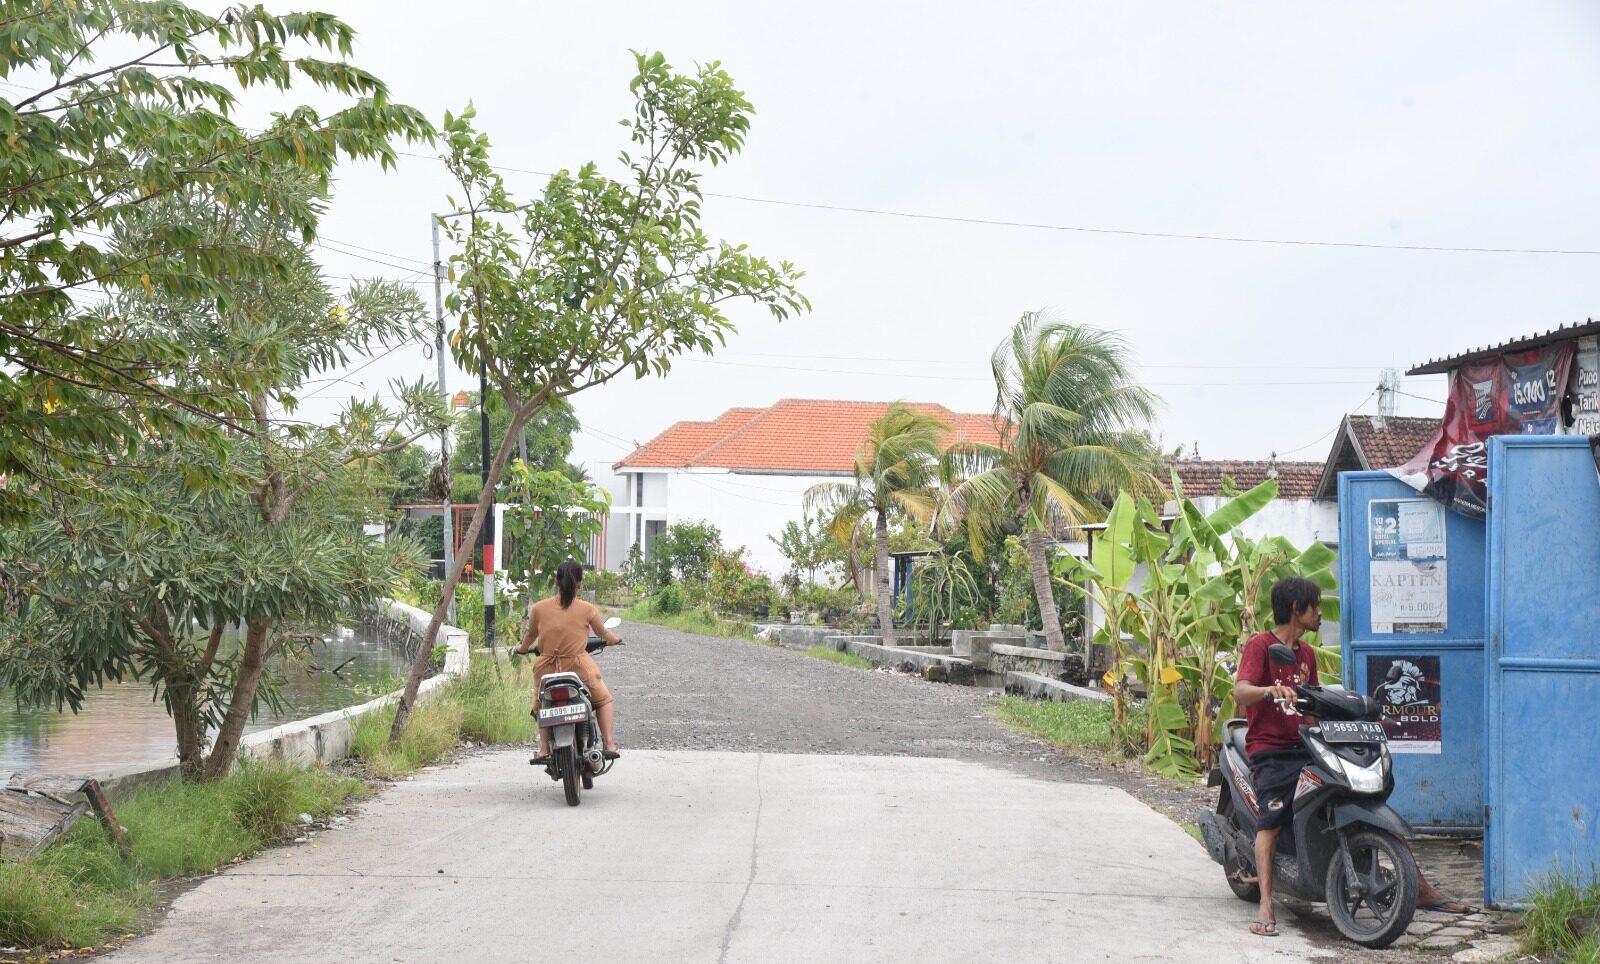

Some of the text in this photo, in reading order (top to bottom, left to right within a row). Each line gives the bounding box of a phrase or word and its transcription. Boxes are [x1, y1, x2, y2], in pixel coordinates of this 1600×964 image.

[1546, 369, 1556, 387] 12
[1514, 379, 1545, 405] 15.000
[1372, 574, 1441, 587] KAPTEN
[1381, 704, 1437, 716] RMOUR
[1322, 723, 1330, 731] W
[1333, 723, 1358, 732] 5653
